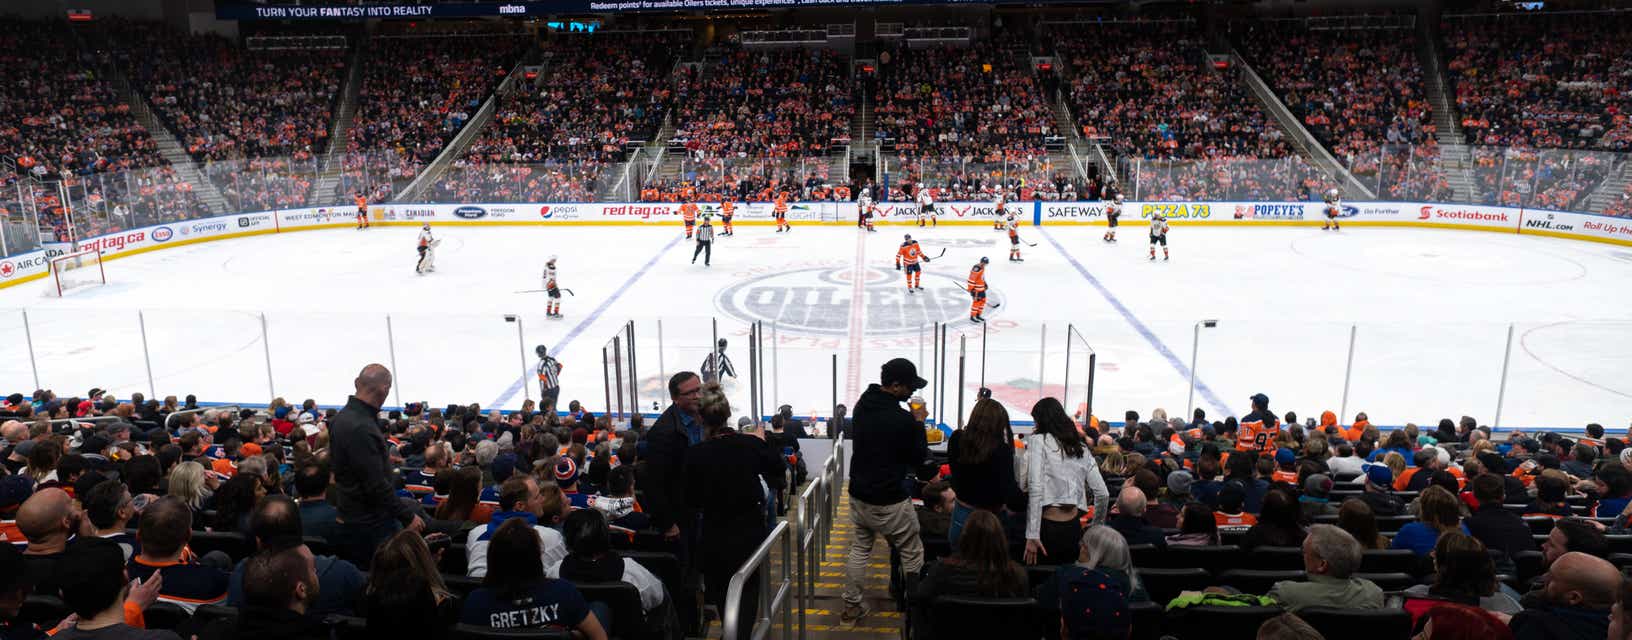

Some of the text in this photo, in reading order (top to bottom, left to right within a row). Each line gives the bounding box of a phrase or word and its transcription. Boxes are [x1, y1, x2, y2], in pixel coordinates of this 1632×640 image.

[499, 5, 526, 14] mbna
[590, 2, 618, 10] Redeem
[642, 1, 652, 9] for
[653, 0, 684, 8] available
[256, 6, 432, 17] TURN YOUR FANTASY INTO REALITY
[553, 206, 578, 215] pepsi
[602, 206, 625, 216] red
[894, 207, 916, 217] JACK
[972, 207, 994, 217] JACK
[1048, 207, 1103, 217] SAFEWAY
[1142, 204, 1210, 218] PIZZA 73
[1253, 204, 1304, 216] POPEYE'S
[1436, 209, 1509, 222] Scotiabank
[192, 222, 227, 233] Synergy
[1583, 221, 1602, 230] Roll
[1604, 223, 1617, 234] Up
[16, 260, 33, 271] AIR
[490, 603, 560, 629] GRETZKY
